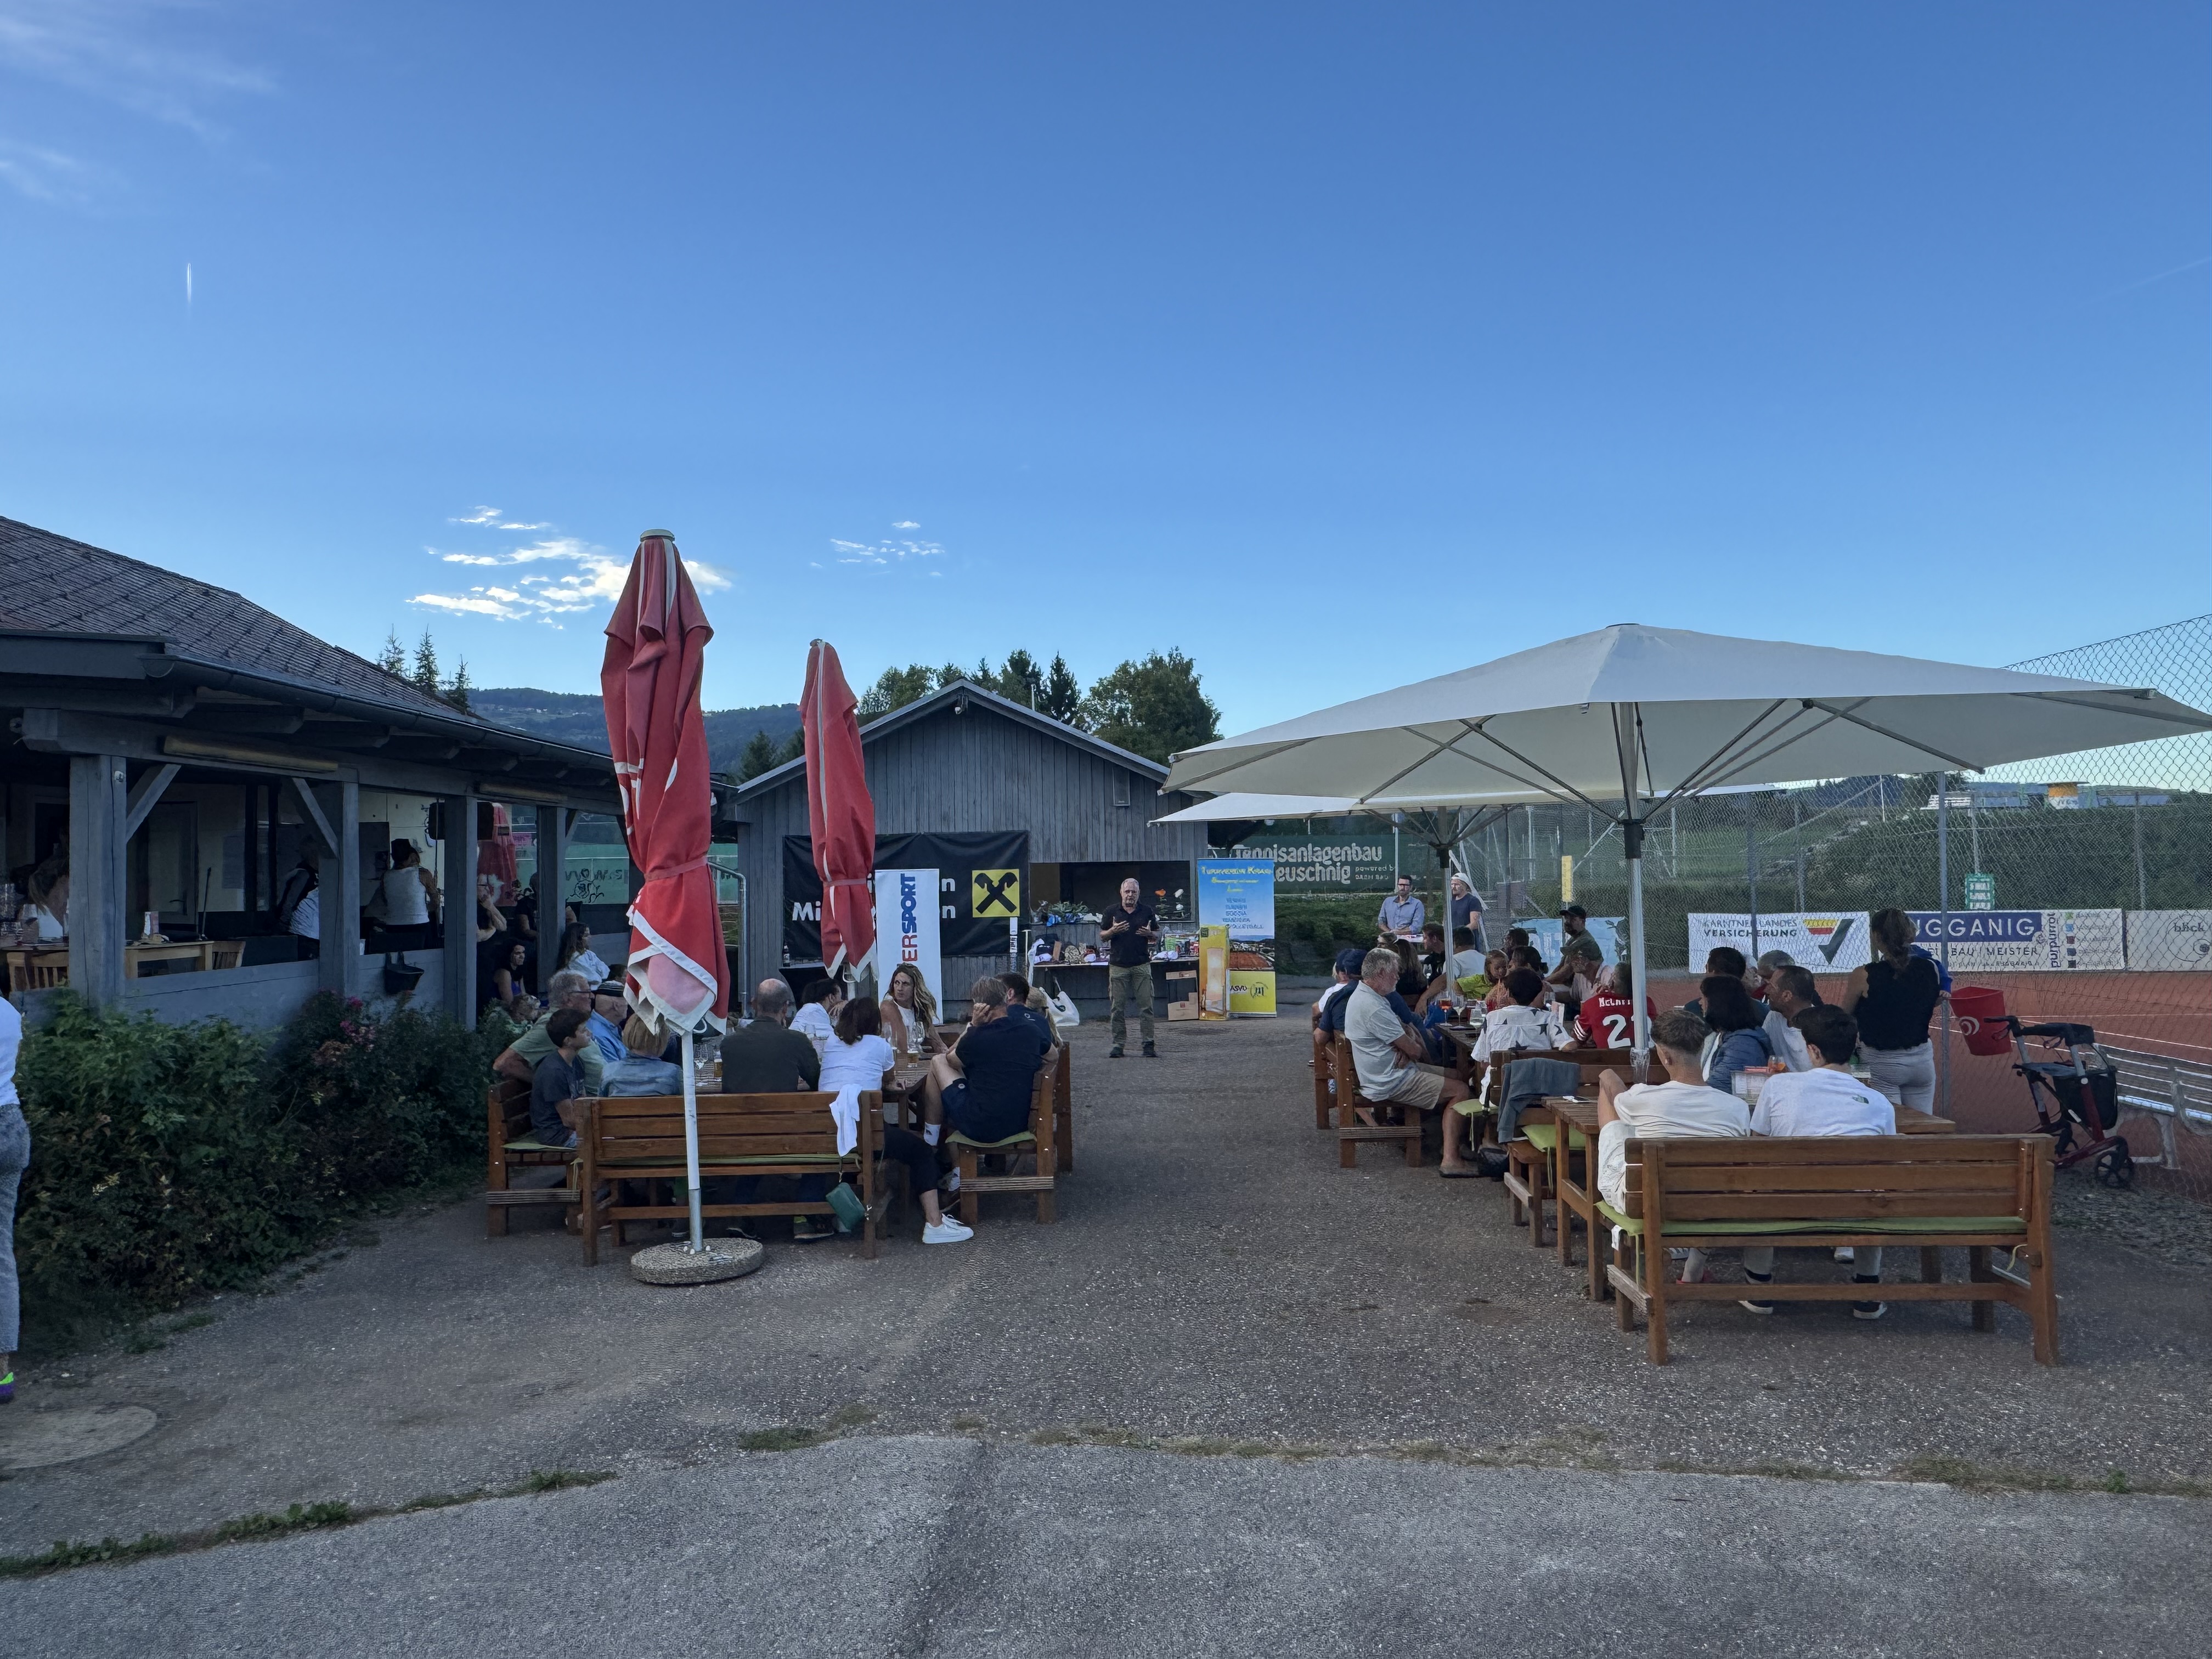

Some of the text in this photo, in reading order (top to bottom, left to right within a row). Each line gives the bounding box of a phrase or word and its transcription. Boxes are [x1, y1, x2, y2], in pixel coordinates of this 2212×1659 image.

[1232, 843, 1382, 865] Tennisanlagenbau
[1274, 862, 1351, 884] euschnig
[900, 873, 918, 962] ERSPORT
[1759, 919, 1797, 927] LANDES
[1602, 1014, 1636, 1049] 2
